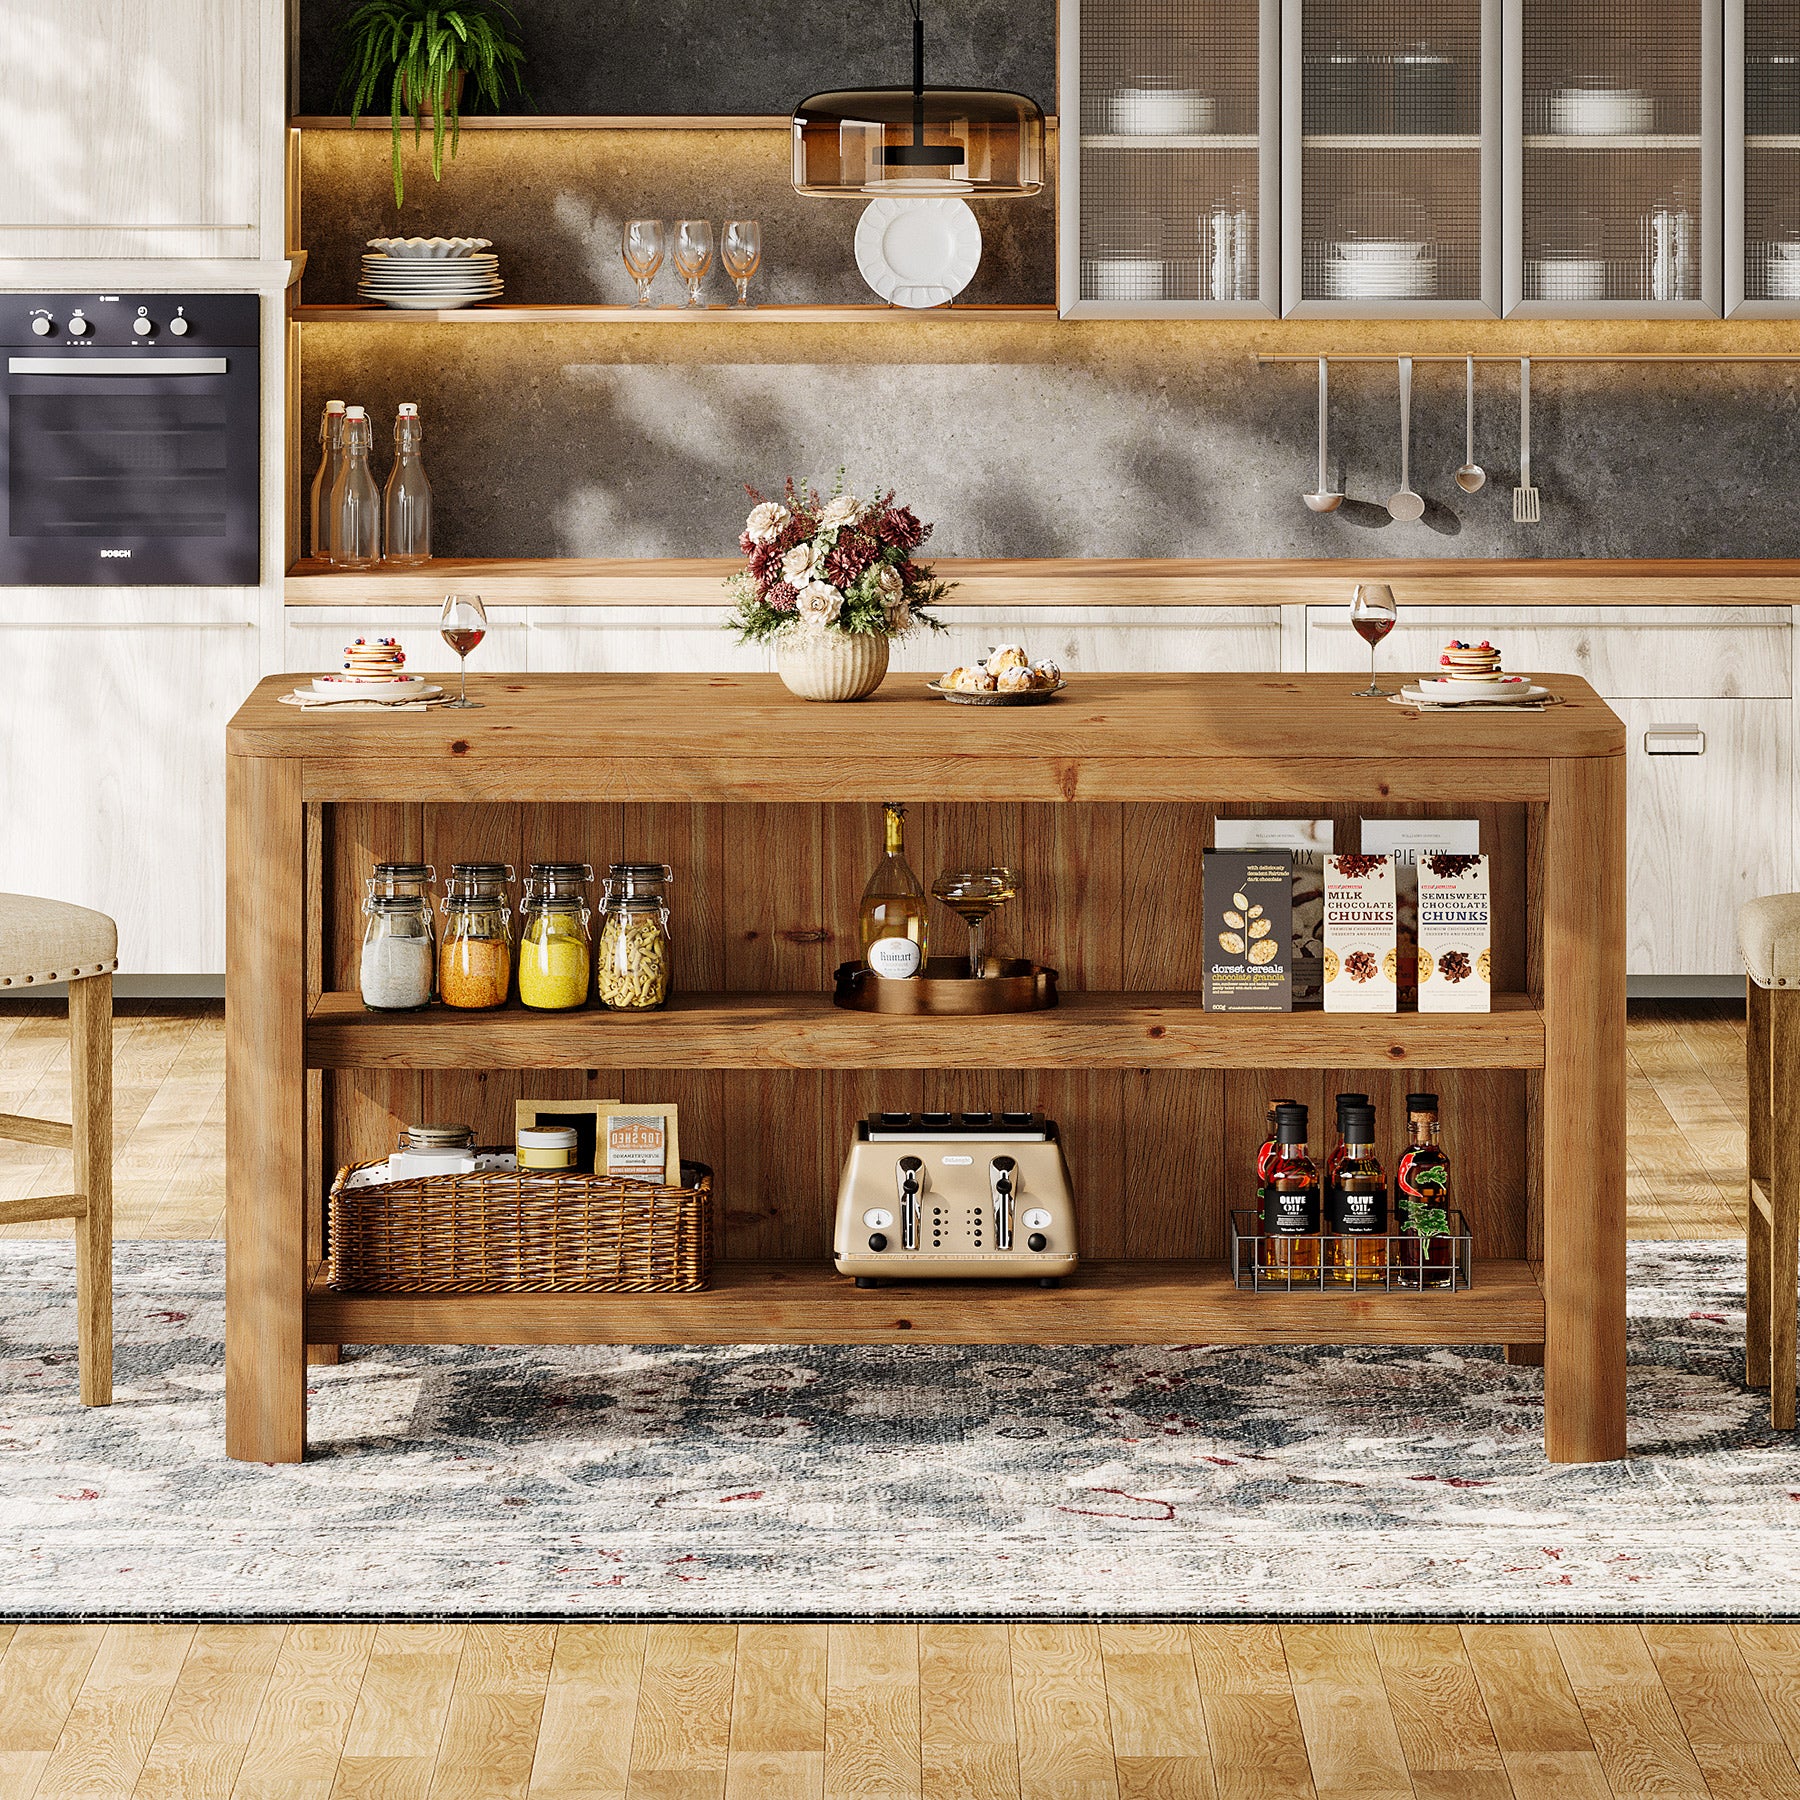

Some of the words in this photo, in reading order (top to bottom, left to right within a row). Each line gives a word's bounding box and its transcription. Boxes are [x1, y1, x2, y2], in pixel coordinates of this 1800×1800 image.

[100, 549, 131, 558] BOSCH
[1394, 849, 1415, 865] PIE
[1328, 892, 1362, 900] MILK
[1328, 911, 1394, 921] CHUNKS
[1422, 911, 1488, 921] CHUNKS
[1211, 964, 1245, 973] dorset
[1246, 964, 1283, 973] cereals
[1253, 974, 1285, 982] granola
[1280, 1196, 1306, 1204] OLIVE
[1347, 1196, 1373, 1204] OLIVE
[1283, 1204, 1303, 1212] OIL
[1350, 1204, 1371, 1212] OIL
